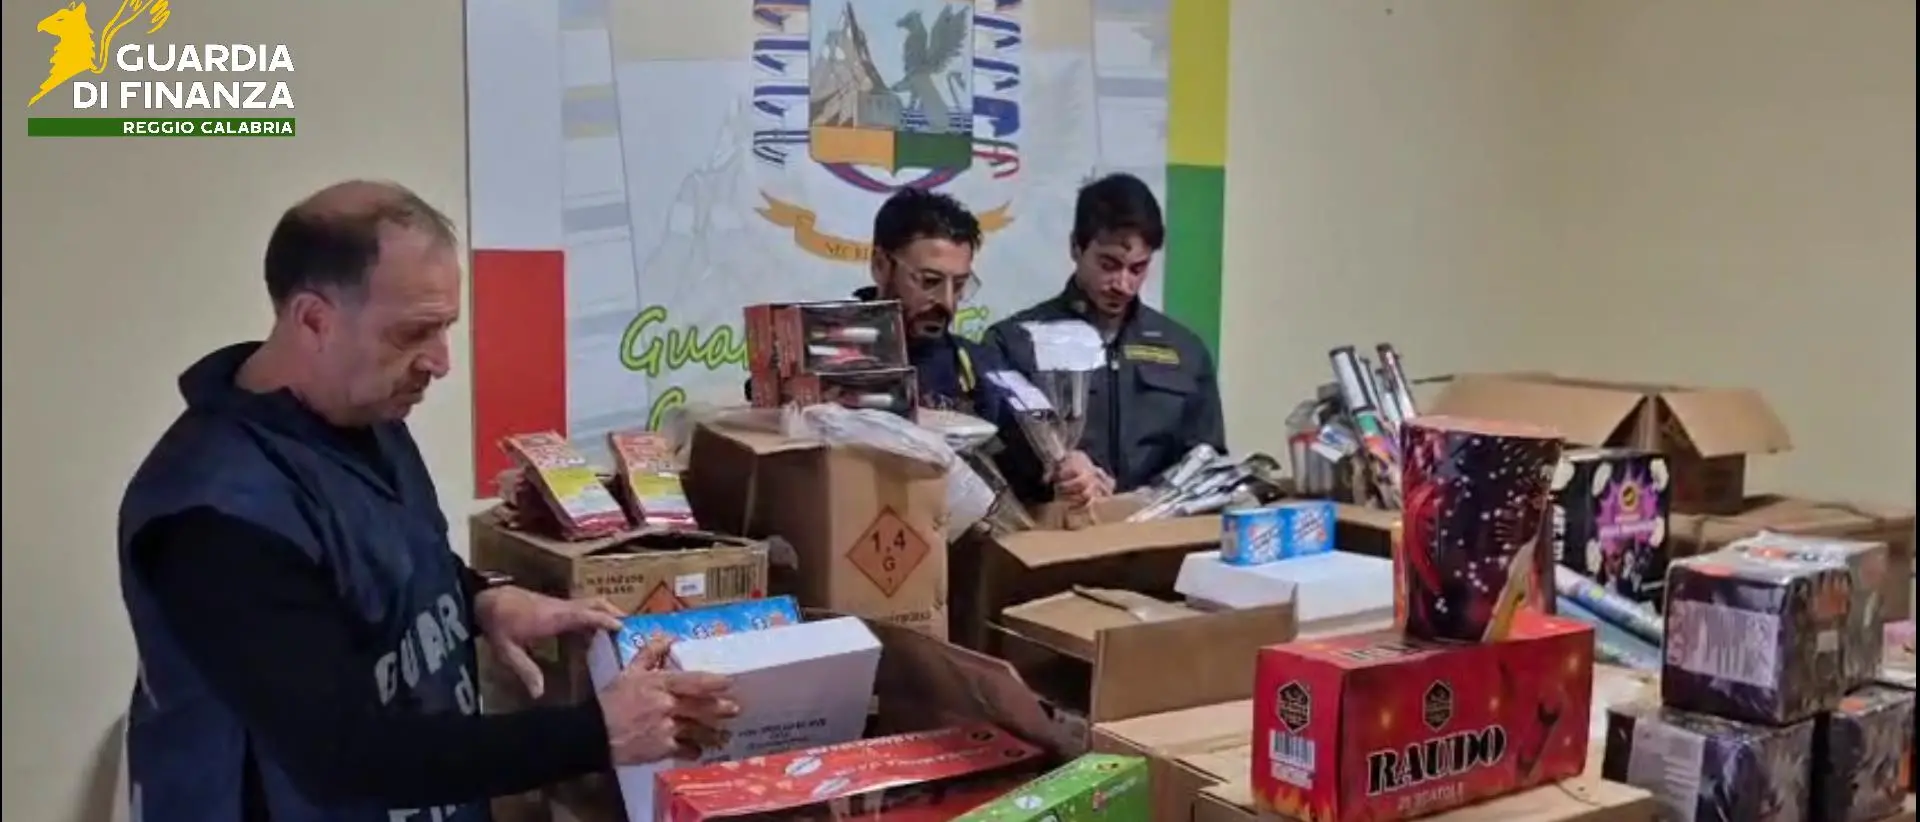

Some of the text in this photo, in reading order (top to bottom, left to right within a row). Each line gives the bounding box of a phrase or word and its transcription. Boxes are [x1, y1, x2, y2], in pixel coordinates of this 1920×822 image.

[621, 305, 748, 377] Gua
[374, 593, 469, 706] GUAR
[1366, 725, 1507, 796] RAUDO
